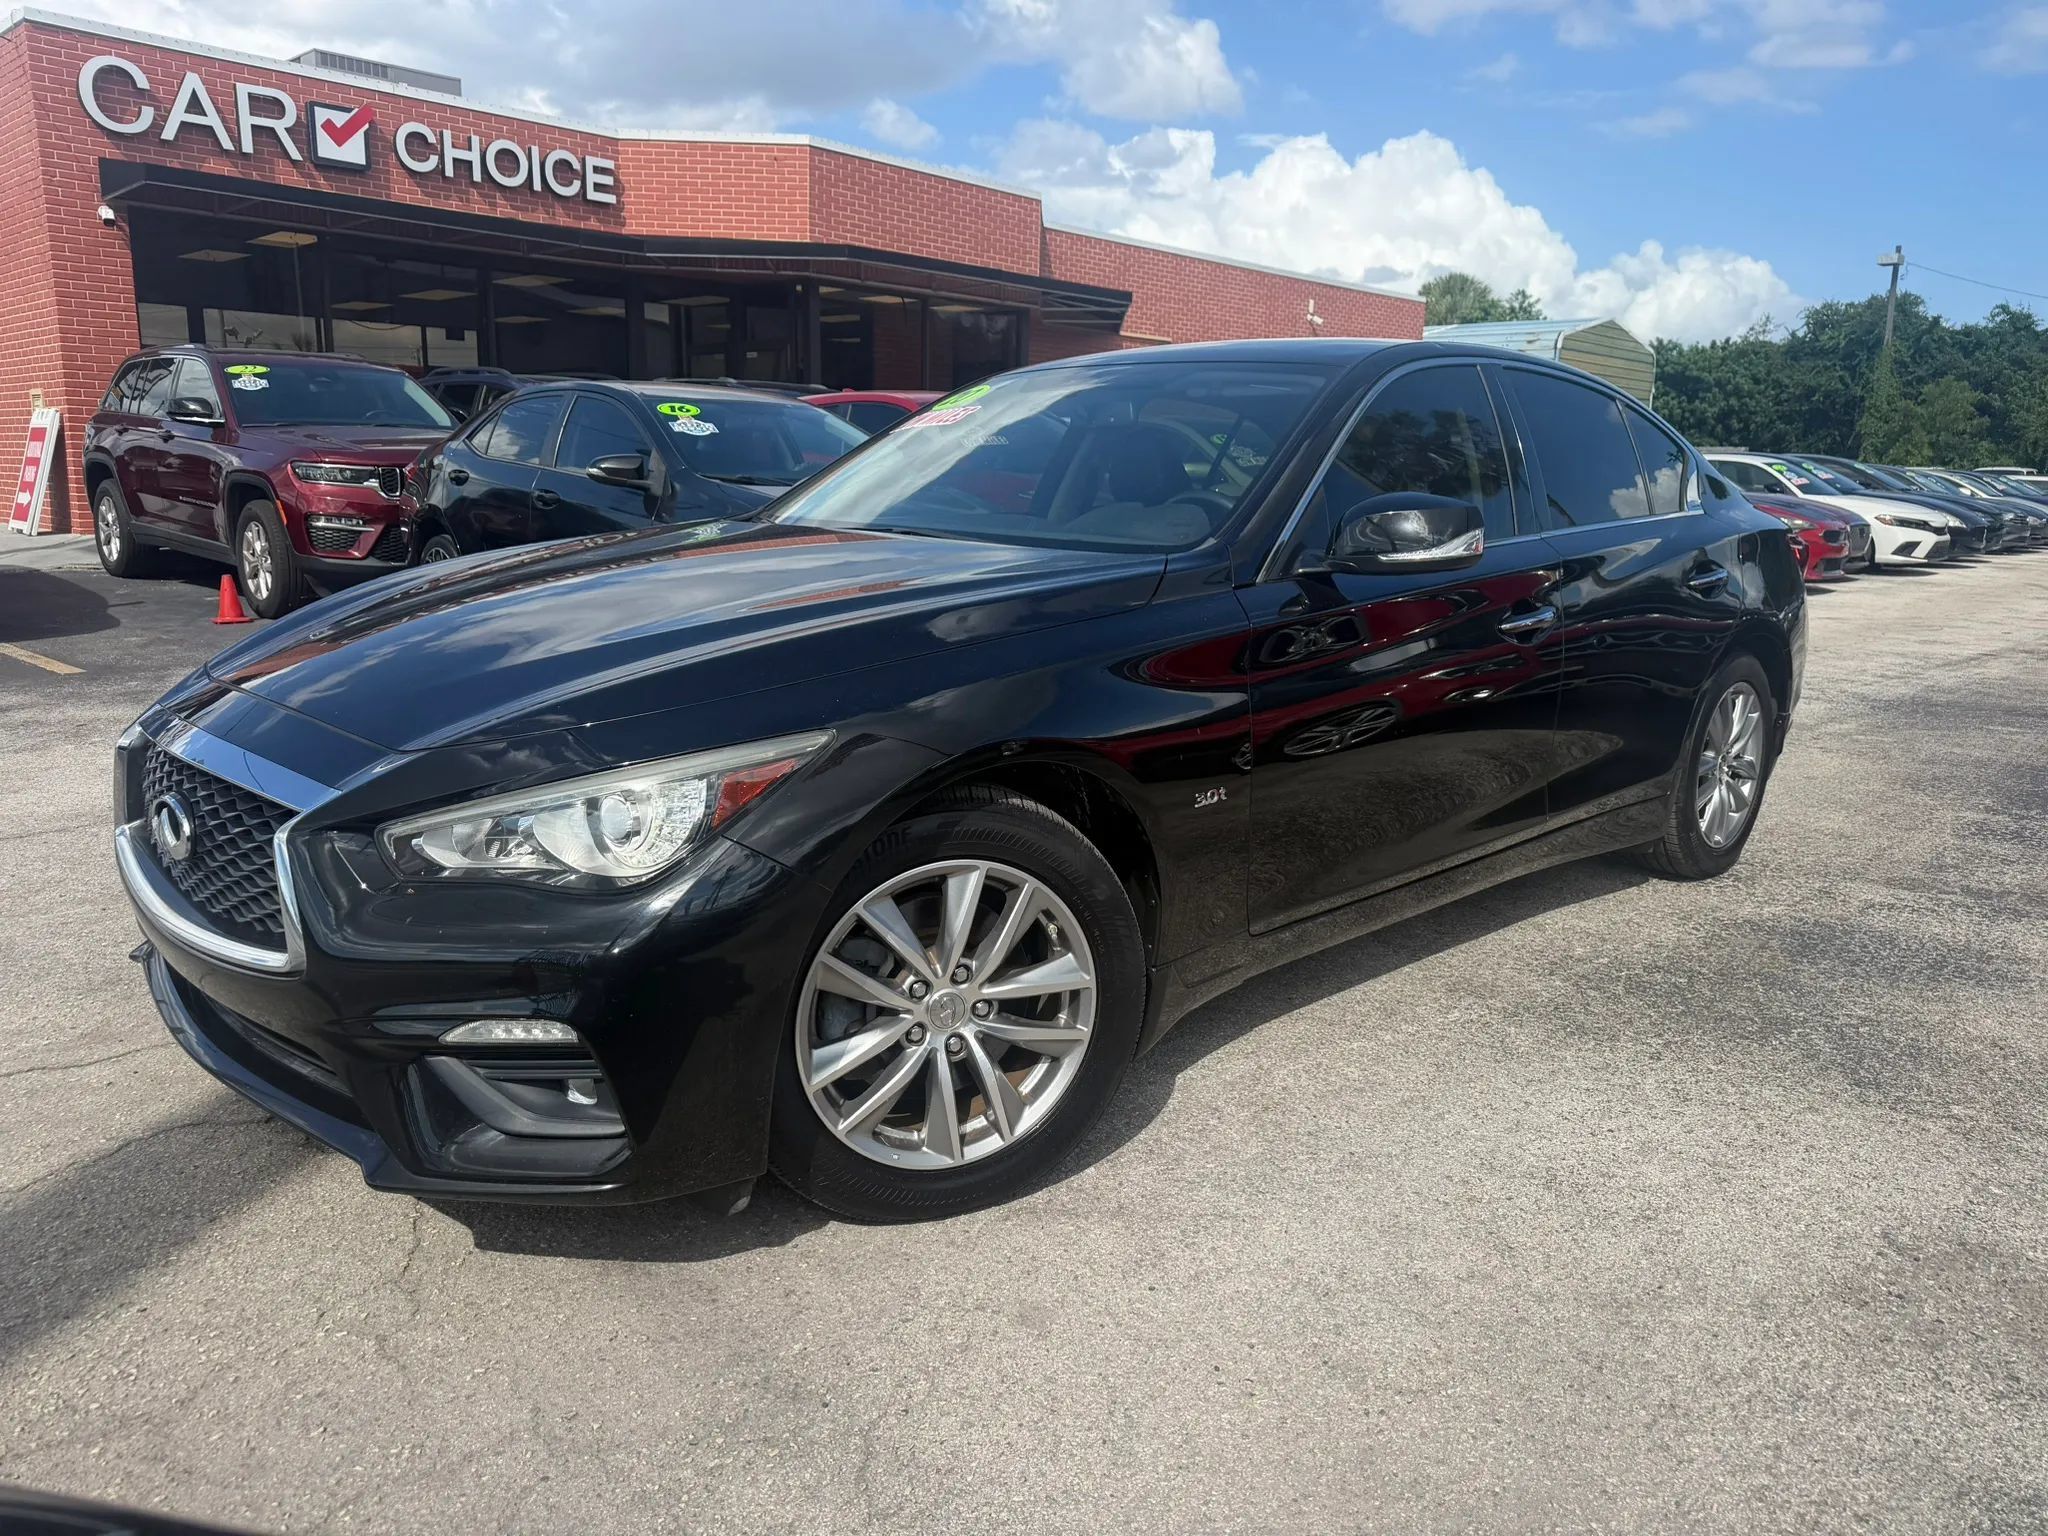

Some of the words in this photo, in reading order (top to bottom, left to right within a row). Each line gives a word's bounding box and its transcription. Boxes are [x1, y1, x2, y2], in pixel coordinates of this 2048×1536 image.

[78, 55, 302, 161] CAR
[395, 121, 617, 205] CHOICE
[668, 405, 691, 414] 16
